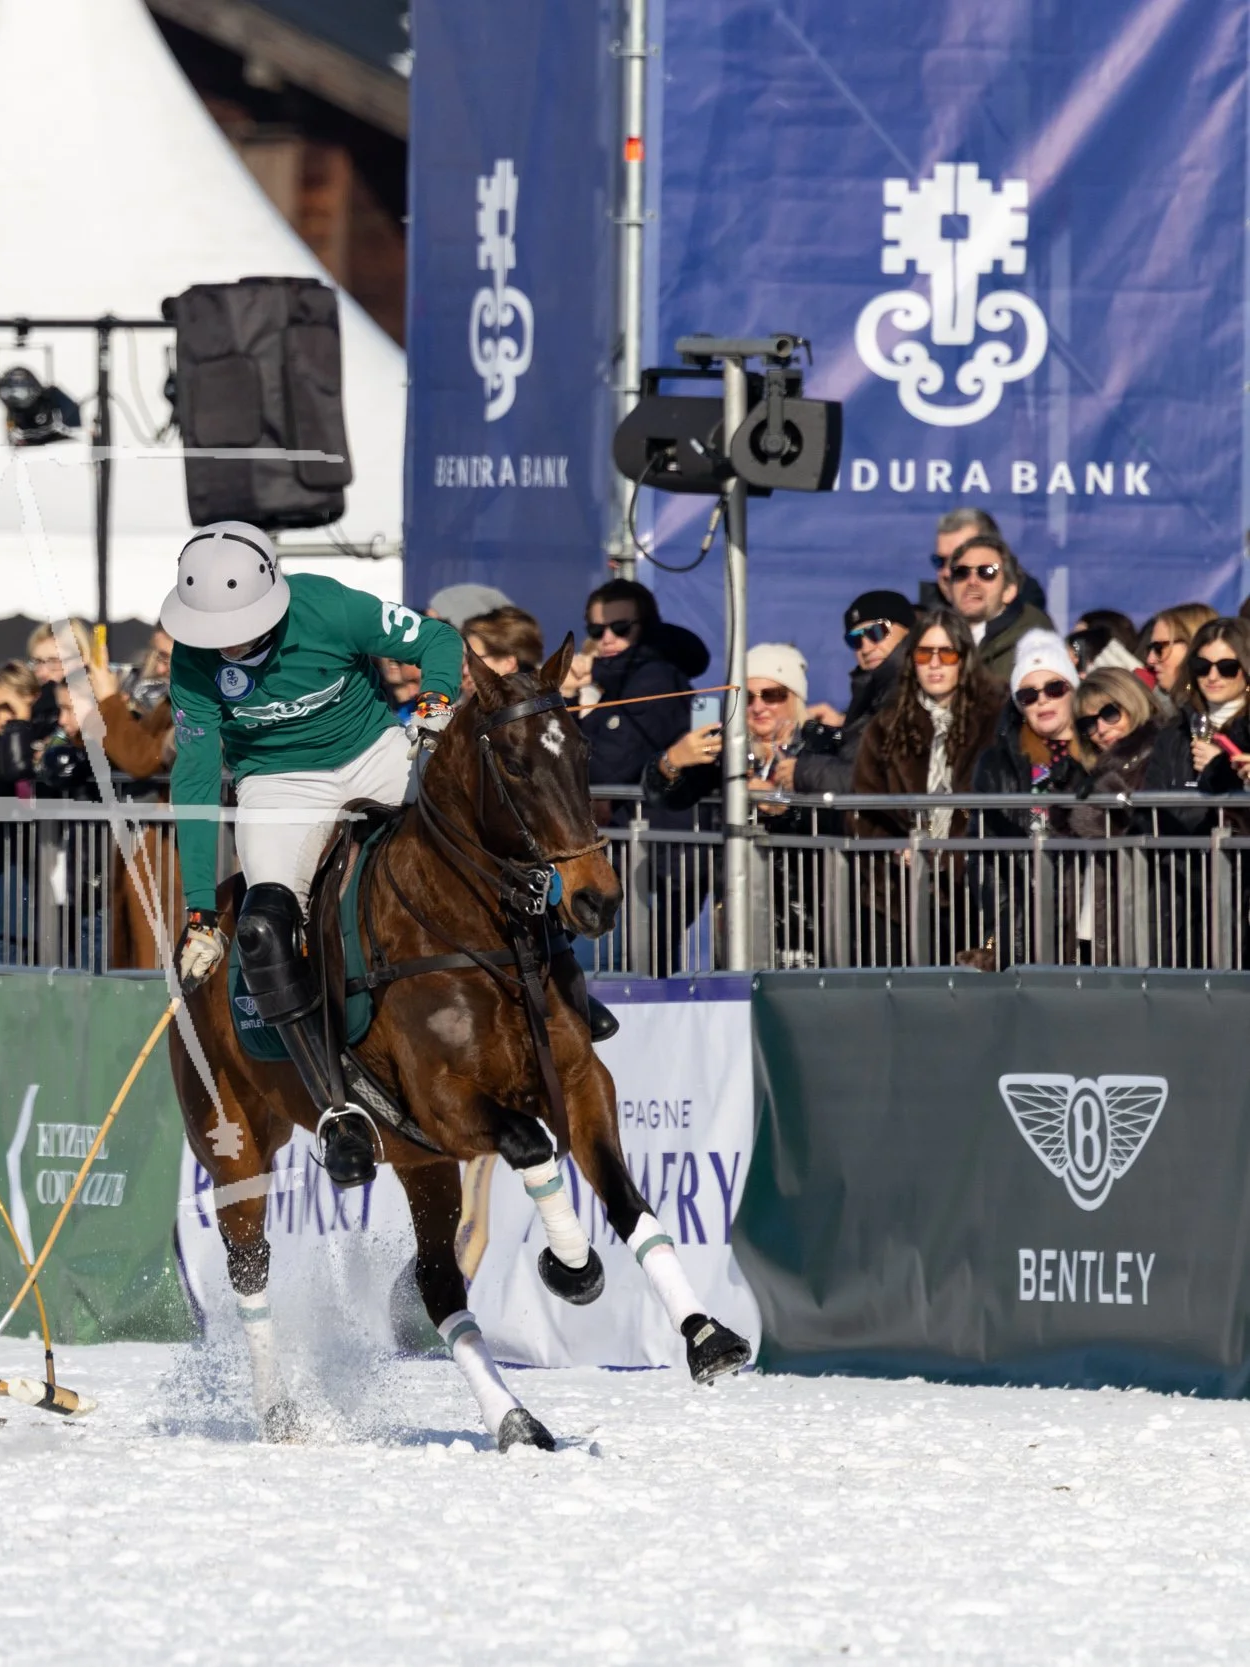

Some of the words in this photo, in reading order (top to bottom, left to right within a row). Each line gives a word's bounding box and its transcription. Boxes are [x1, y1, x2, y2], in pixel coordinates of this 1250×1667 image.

[519, 455, 569, 488] BANK
[833, 458, 991, 493] DURA
[1010, 460, 1151, 496] BANK
[381, 601, 422, 643] 3
[618, 1100, 692, 1130] PAGNE
[1018, 1248, 1156, 1306] BENTLEY
